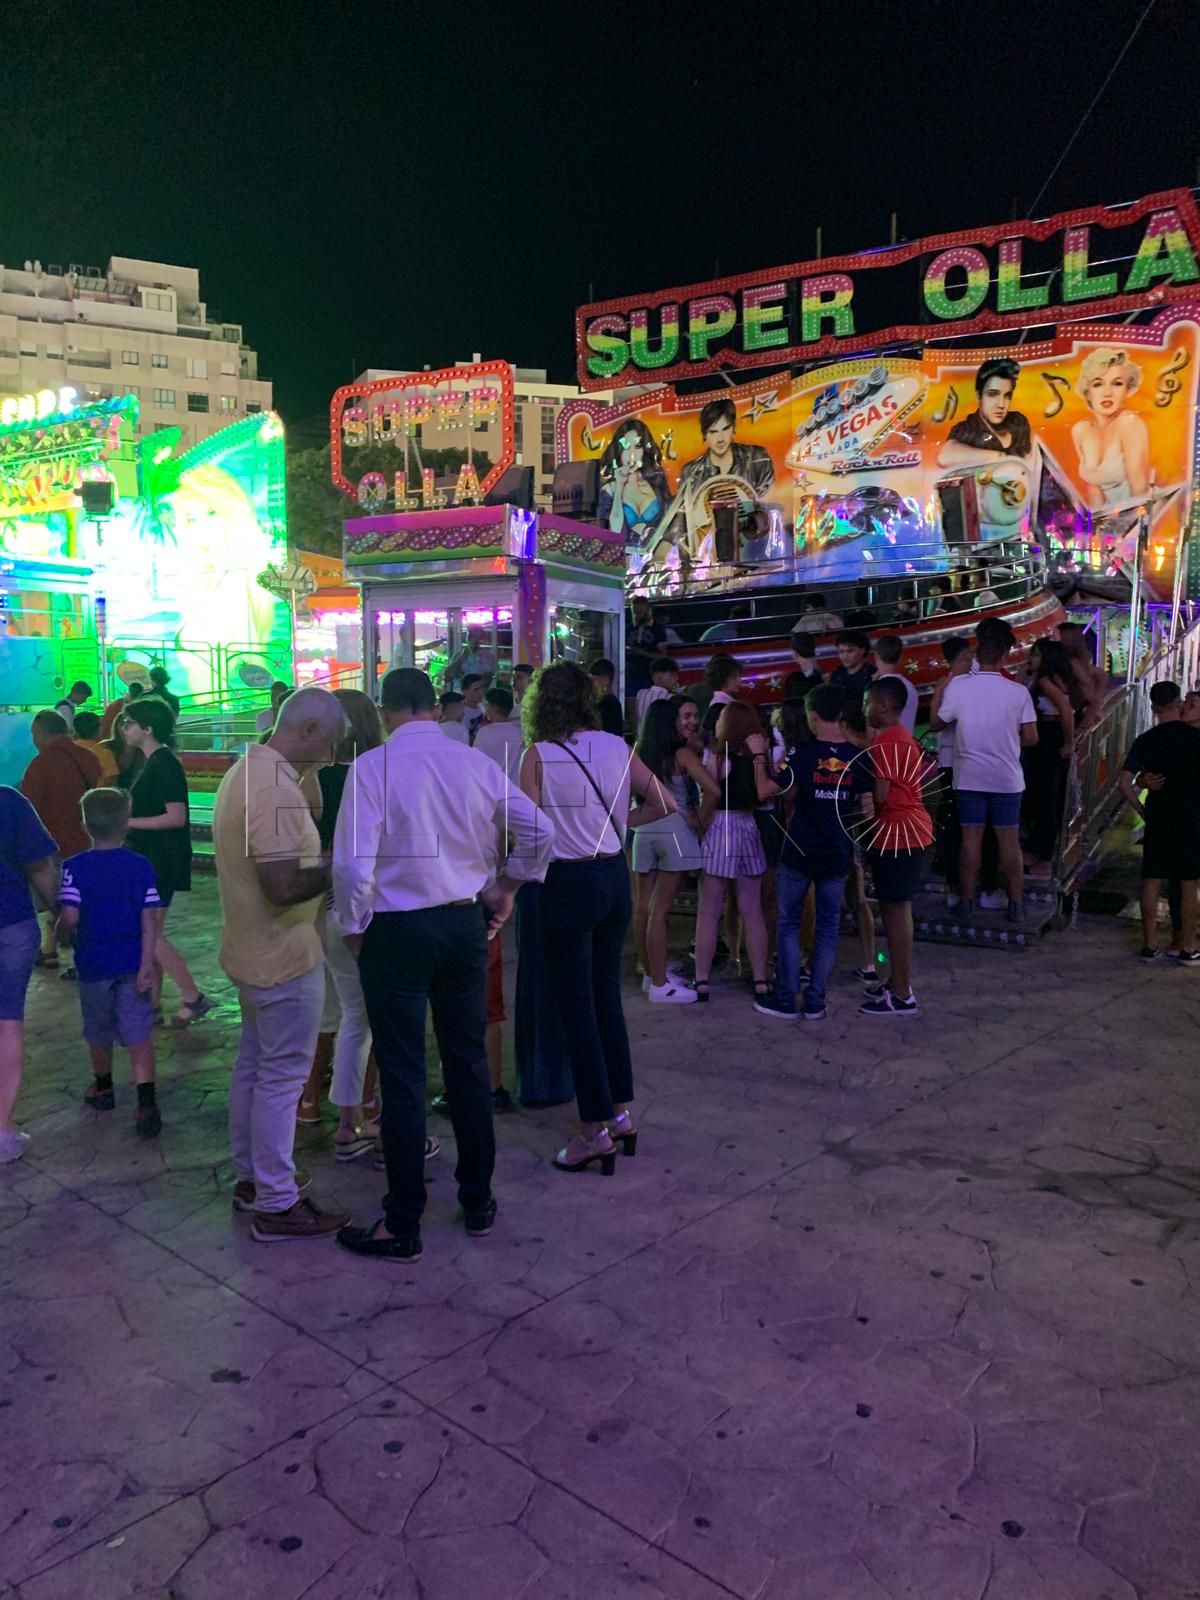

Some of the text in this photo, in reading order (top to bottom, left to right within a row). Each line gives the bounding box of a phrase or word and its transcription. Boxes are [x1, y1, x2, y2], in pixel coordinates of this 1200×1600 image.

[585, 208, 1200, 378] SUPER OLLA
[341, 386, 500, 447] SUPER
[826, 394, 898, 445] VEGAS
[831, 457, 871, 471] Rock
[884, 452, 918, 465] Roll
[357, 463, 483, 513] OLLA
